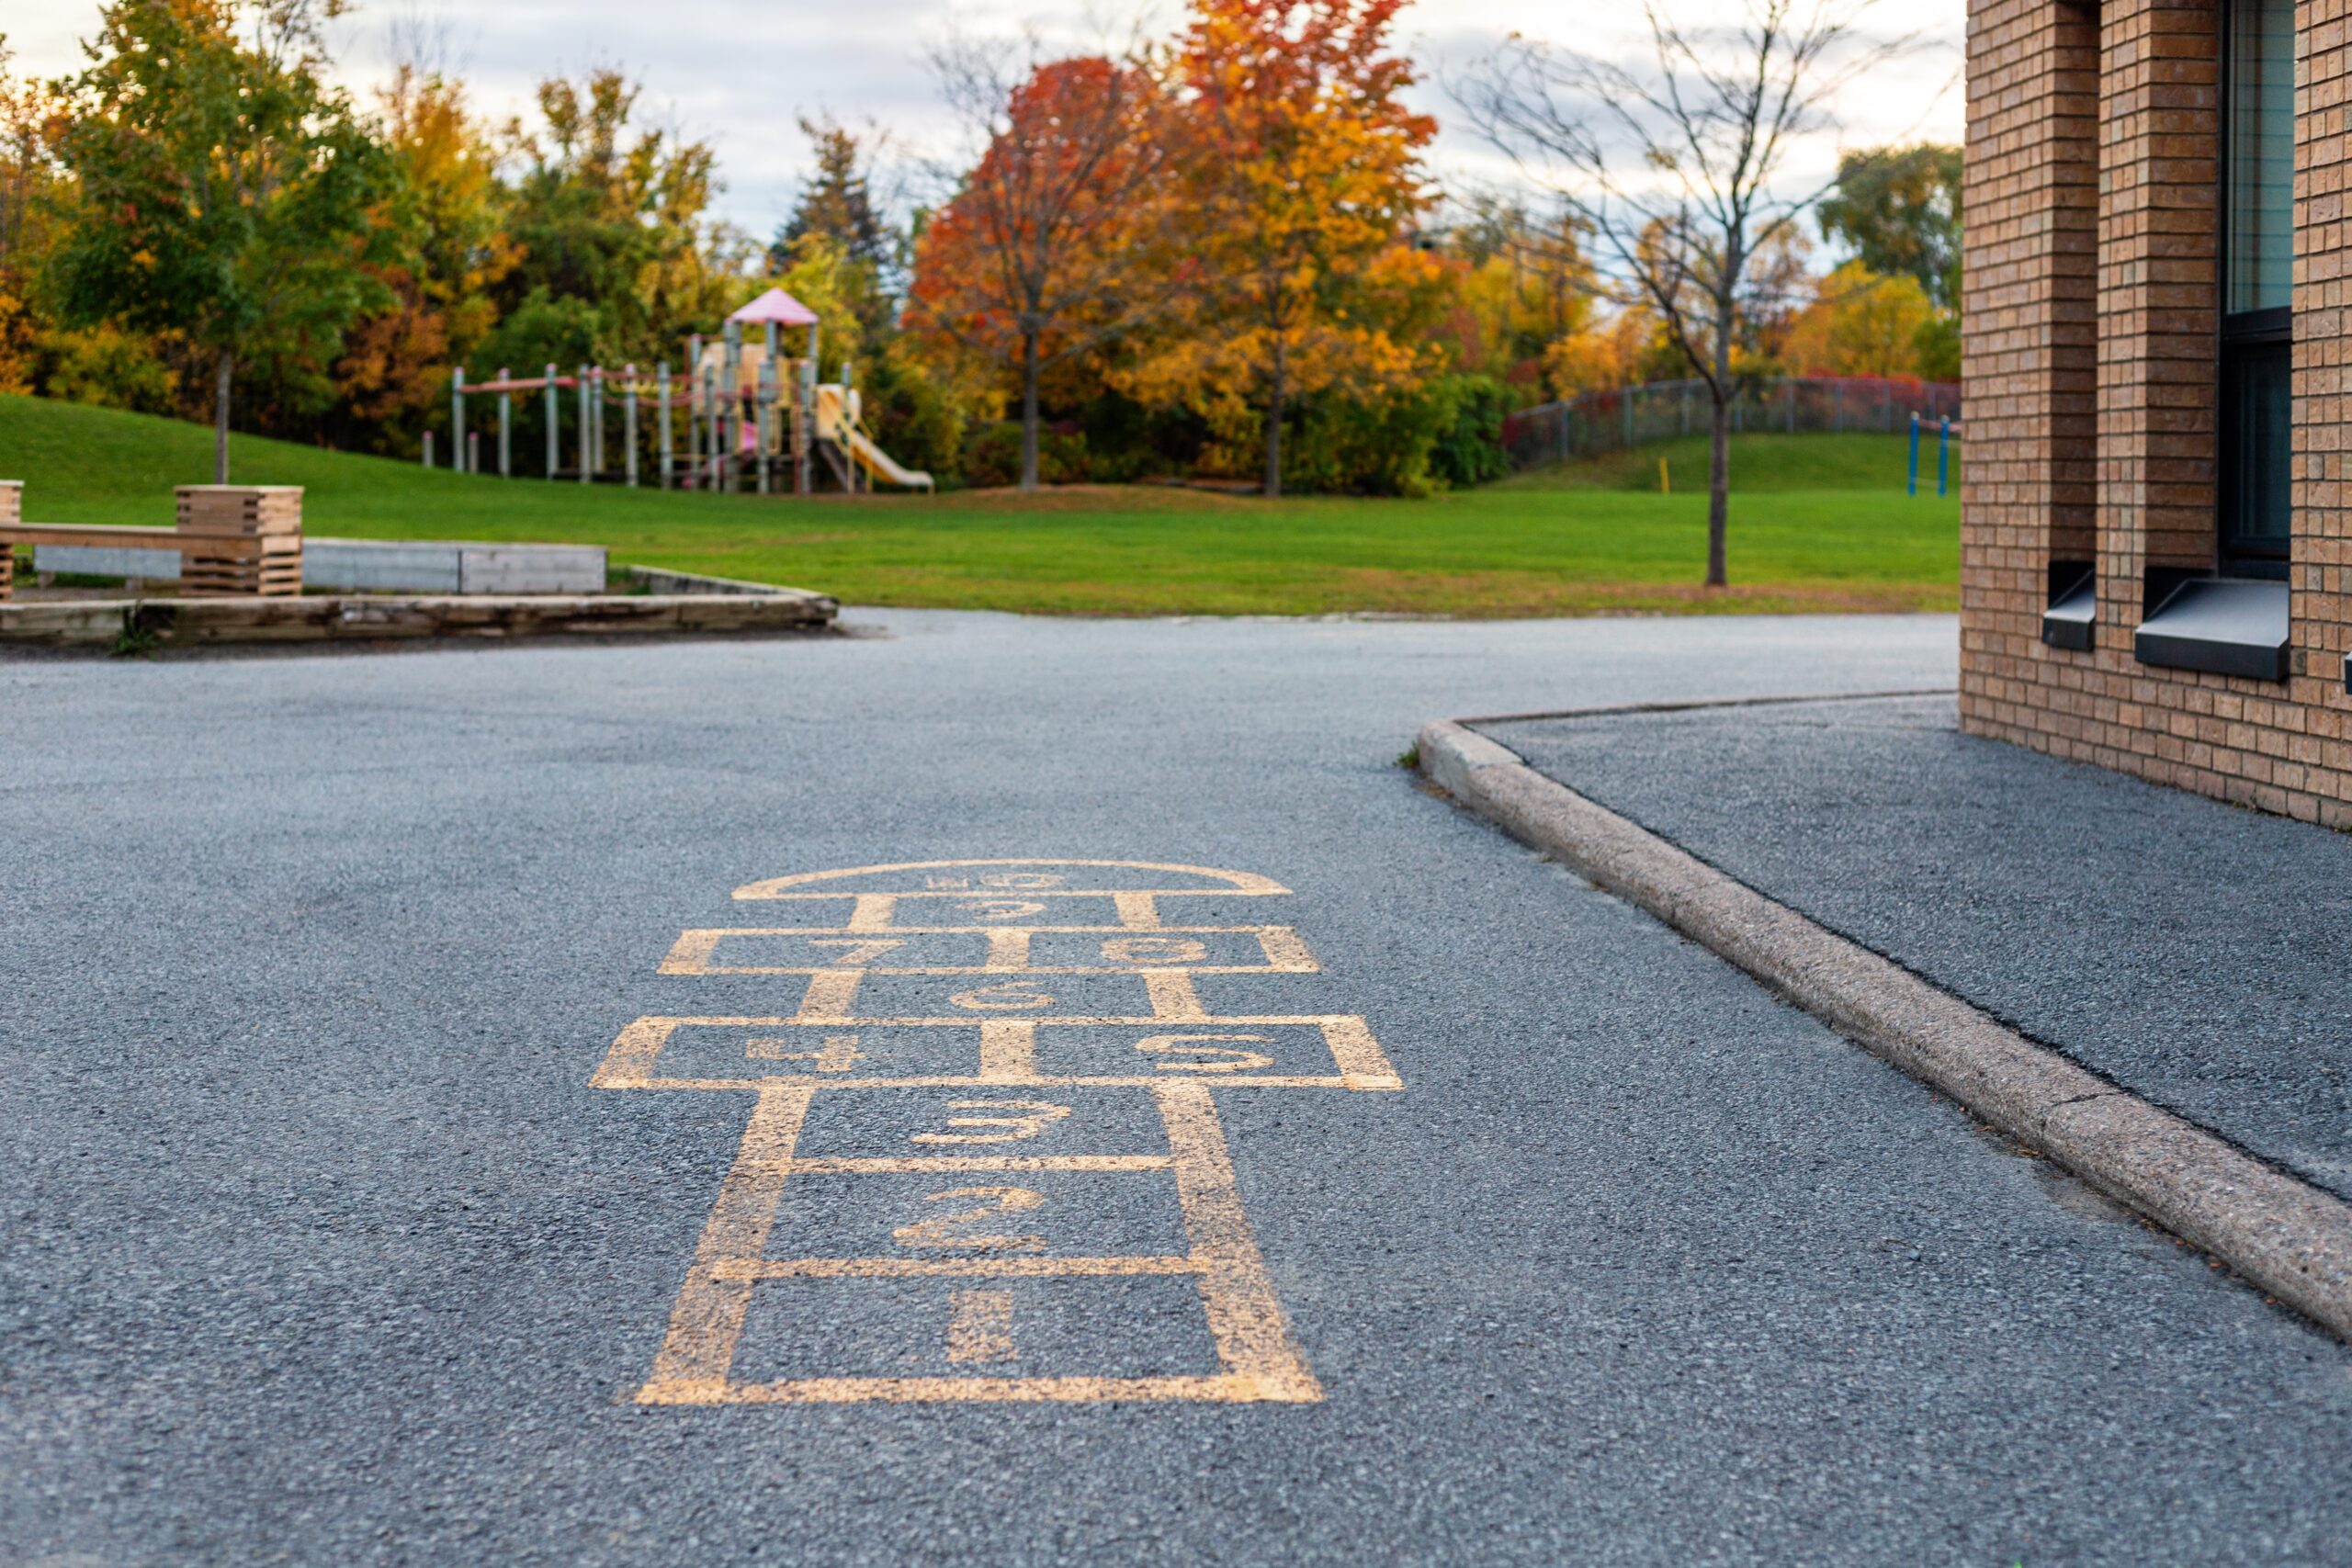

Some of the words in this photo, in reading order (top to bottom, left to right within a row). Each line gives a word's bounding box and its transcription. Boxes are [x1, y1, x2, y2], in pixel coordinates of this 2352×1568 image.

[955, 899, 1047, 920] 9
[808, 938, 908, 964] 7
[1102, 937, 1206, 964] 8
[949, 981, 1055, 1010] 6
[745, 1034, 865, 1073] 4
[1135, 1033, 1276, 1072] 5
[910, 1099, 1072, 1145] 3
[892, 1186, 1047, 1252] 2
[946, 1289, 1018, 1364] 1
